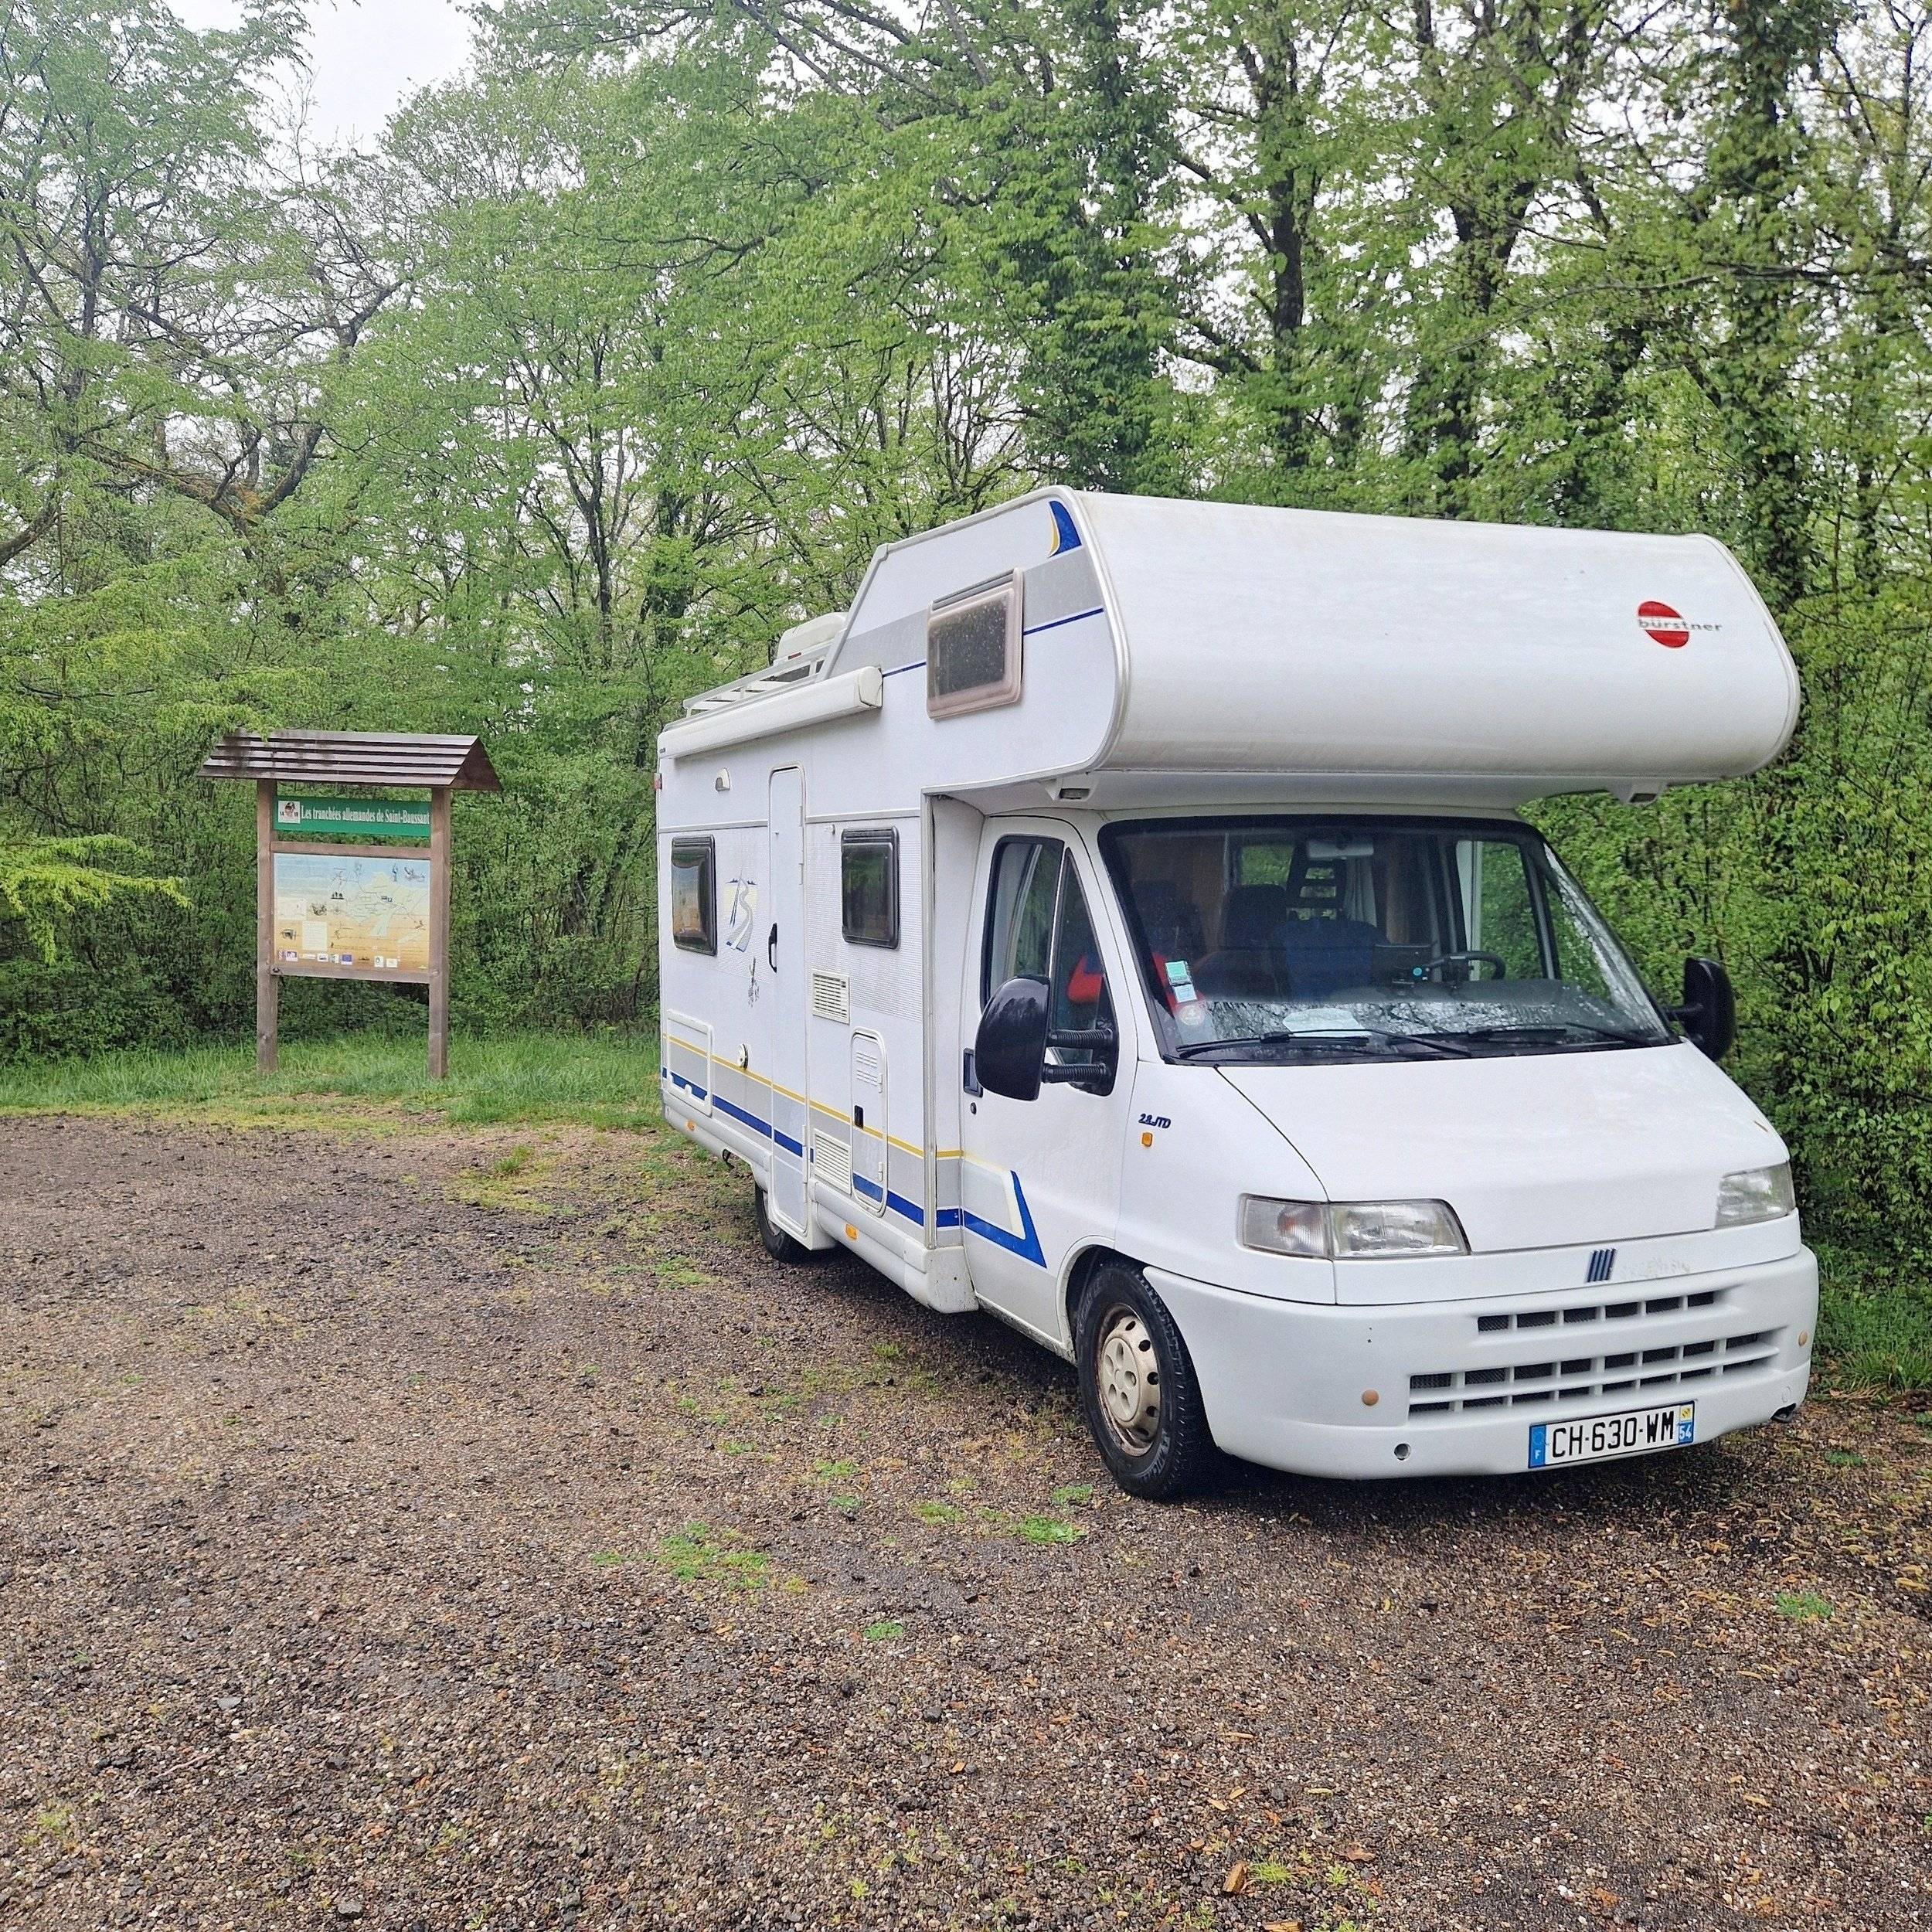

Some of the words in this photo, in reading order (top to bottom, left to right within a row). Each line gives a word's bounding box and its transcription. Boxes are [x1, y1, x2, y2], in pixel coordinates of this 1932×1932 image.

[1638, 618, 1723, 631] bürstner
[301, 804, 311, 819] Les
[313, 806, 341, 821] tranchées
[342, 808, 376, 822] allemandes
[376, 808, 384, 822] de
[385, 808, 430, 825] Saint-Baussant
[1552, 1410, 1675, 1458] CH-630-WM
[1679, 1425, 1692, 1440] 54
[1534, 1449, 1542, 1460] F
